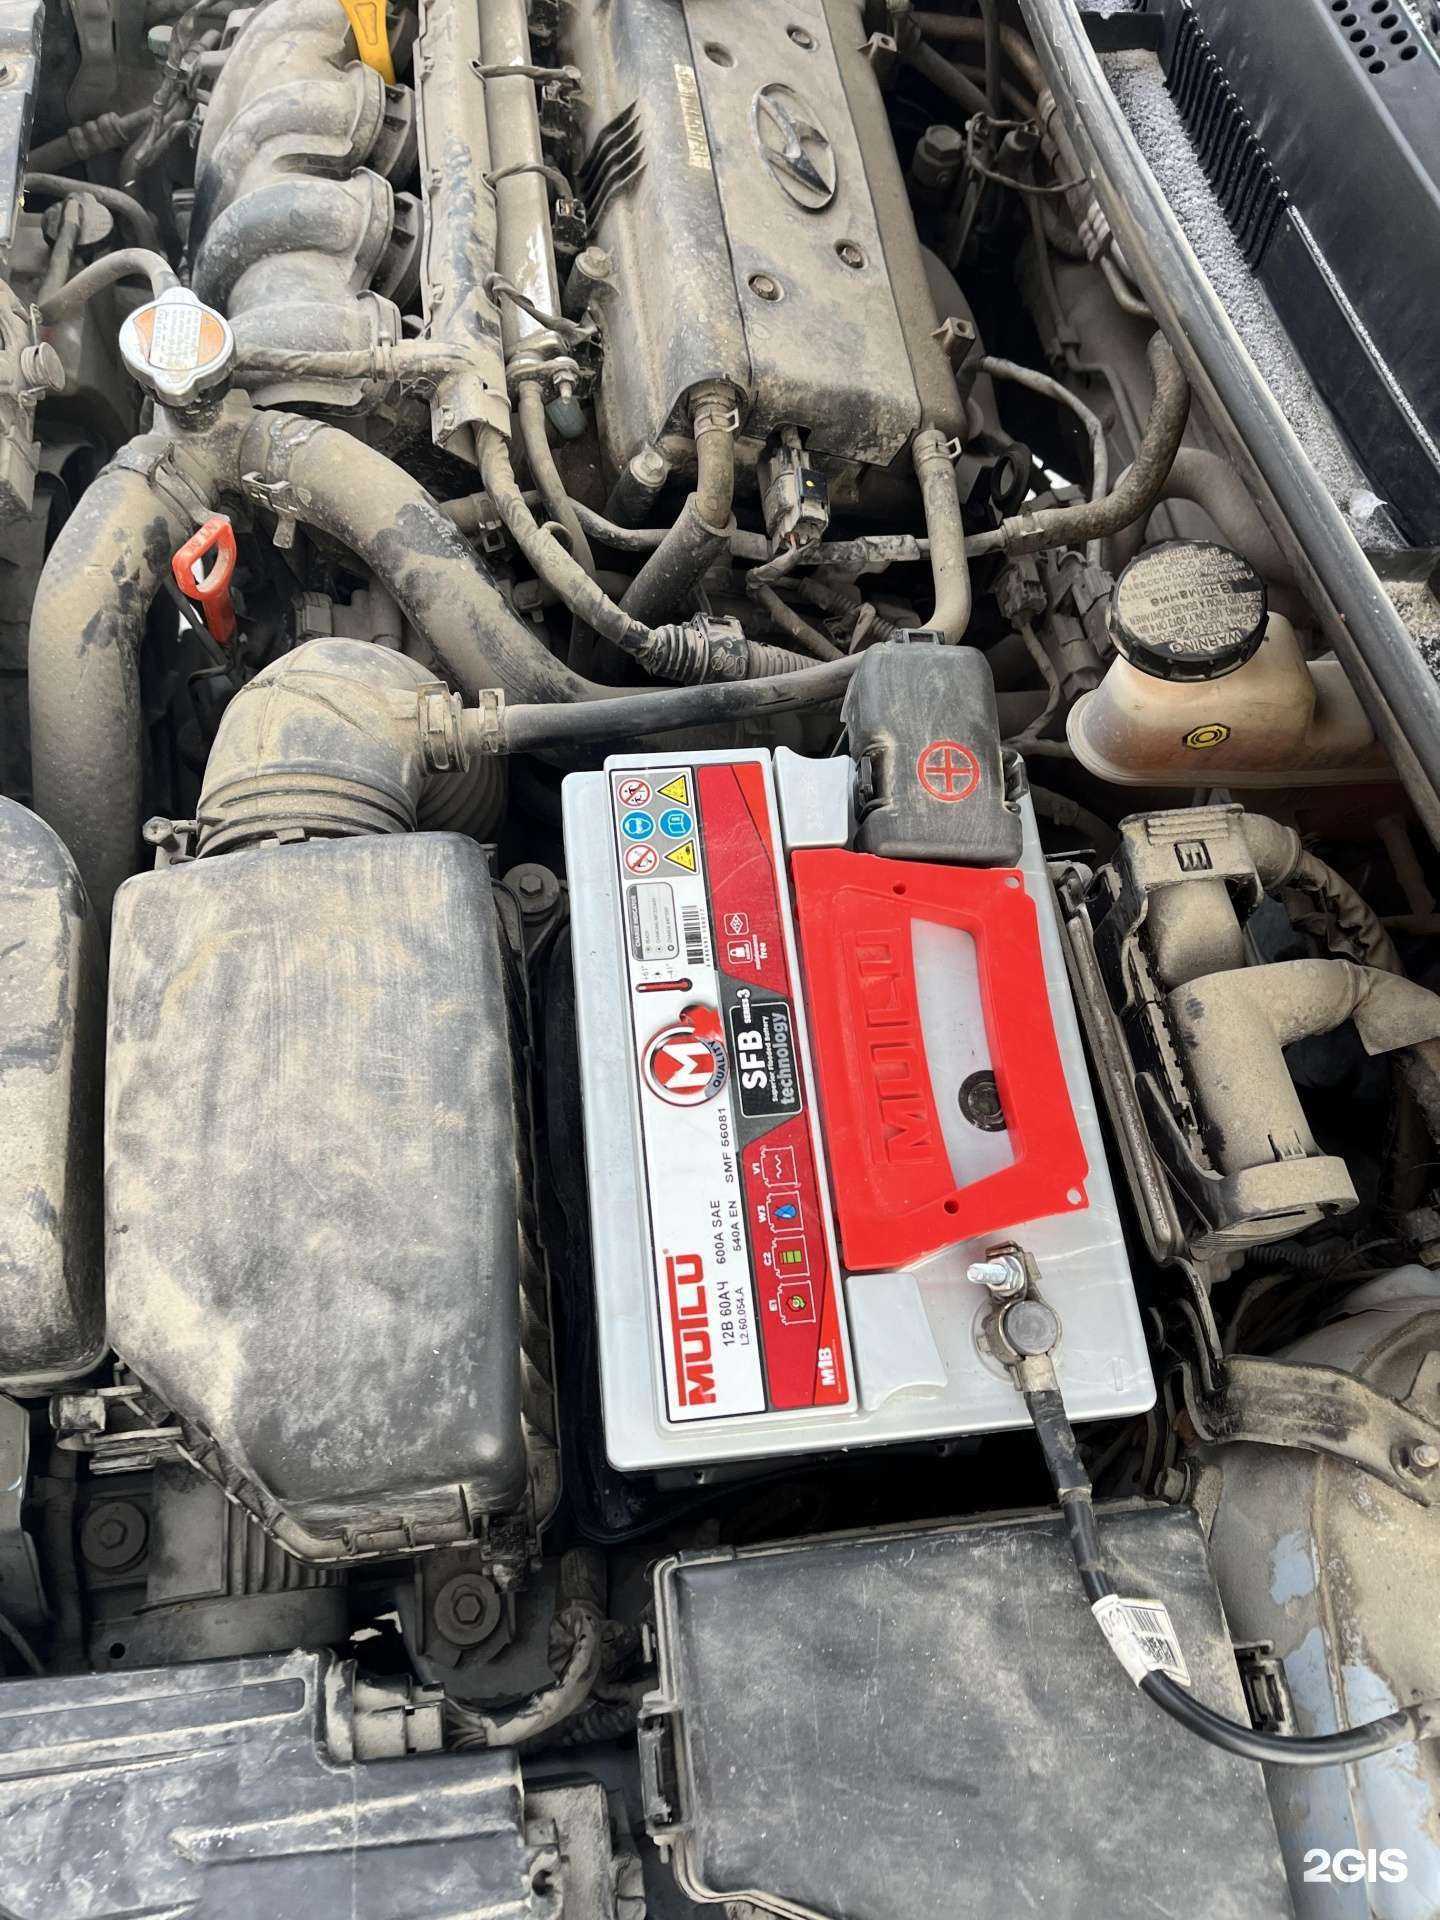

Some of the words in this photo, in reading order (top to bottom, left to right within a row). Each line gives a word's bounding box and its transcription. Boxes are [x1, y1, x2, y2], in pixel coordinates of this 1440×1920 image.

[1169, 631, 1242, 655] WARNING
[762, 1016, 770, 1041] Battery
[737, 1030, 768, 1089] SFB
[765, 1042, 774, 1070] Flooded
[771, 1012, 795, 1104] technology
[841, 928, 934, 1165] MUTLU
[707, 1039, 726, 1088] QUALITY
[769, 1072, 778, 1102] Superior
[718, 1107, 730, 1146] 56081
[723, 1152, 734, 1183] SMF
[710, 1200, 722, 1227] SAE
[729, 1200, 738, 1217] EN
[713, 1232, 726, 1264] 600A
[729, 1222, 741, 1251] 540A
[666, 1253, 717, 1407] MUTLU
[735, 1287, 750, 1346] L2.60.054.A
